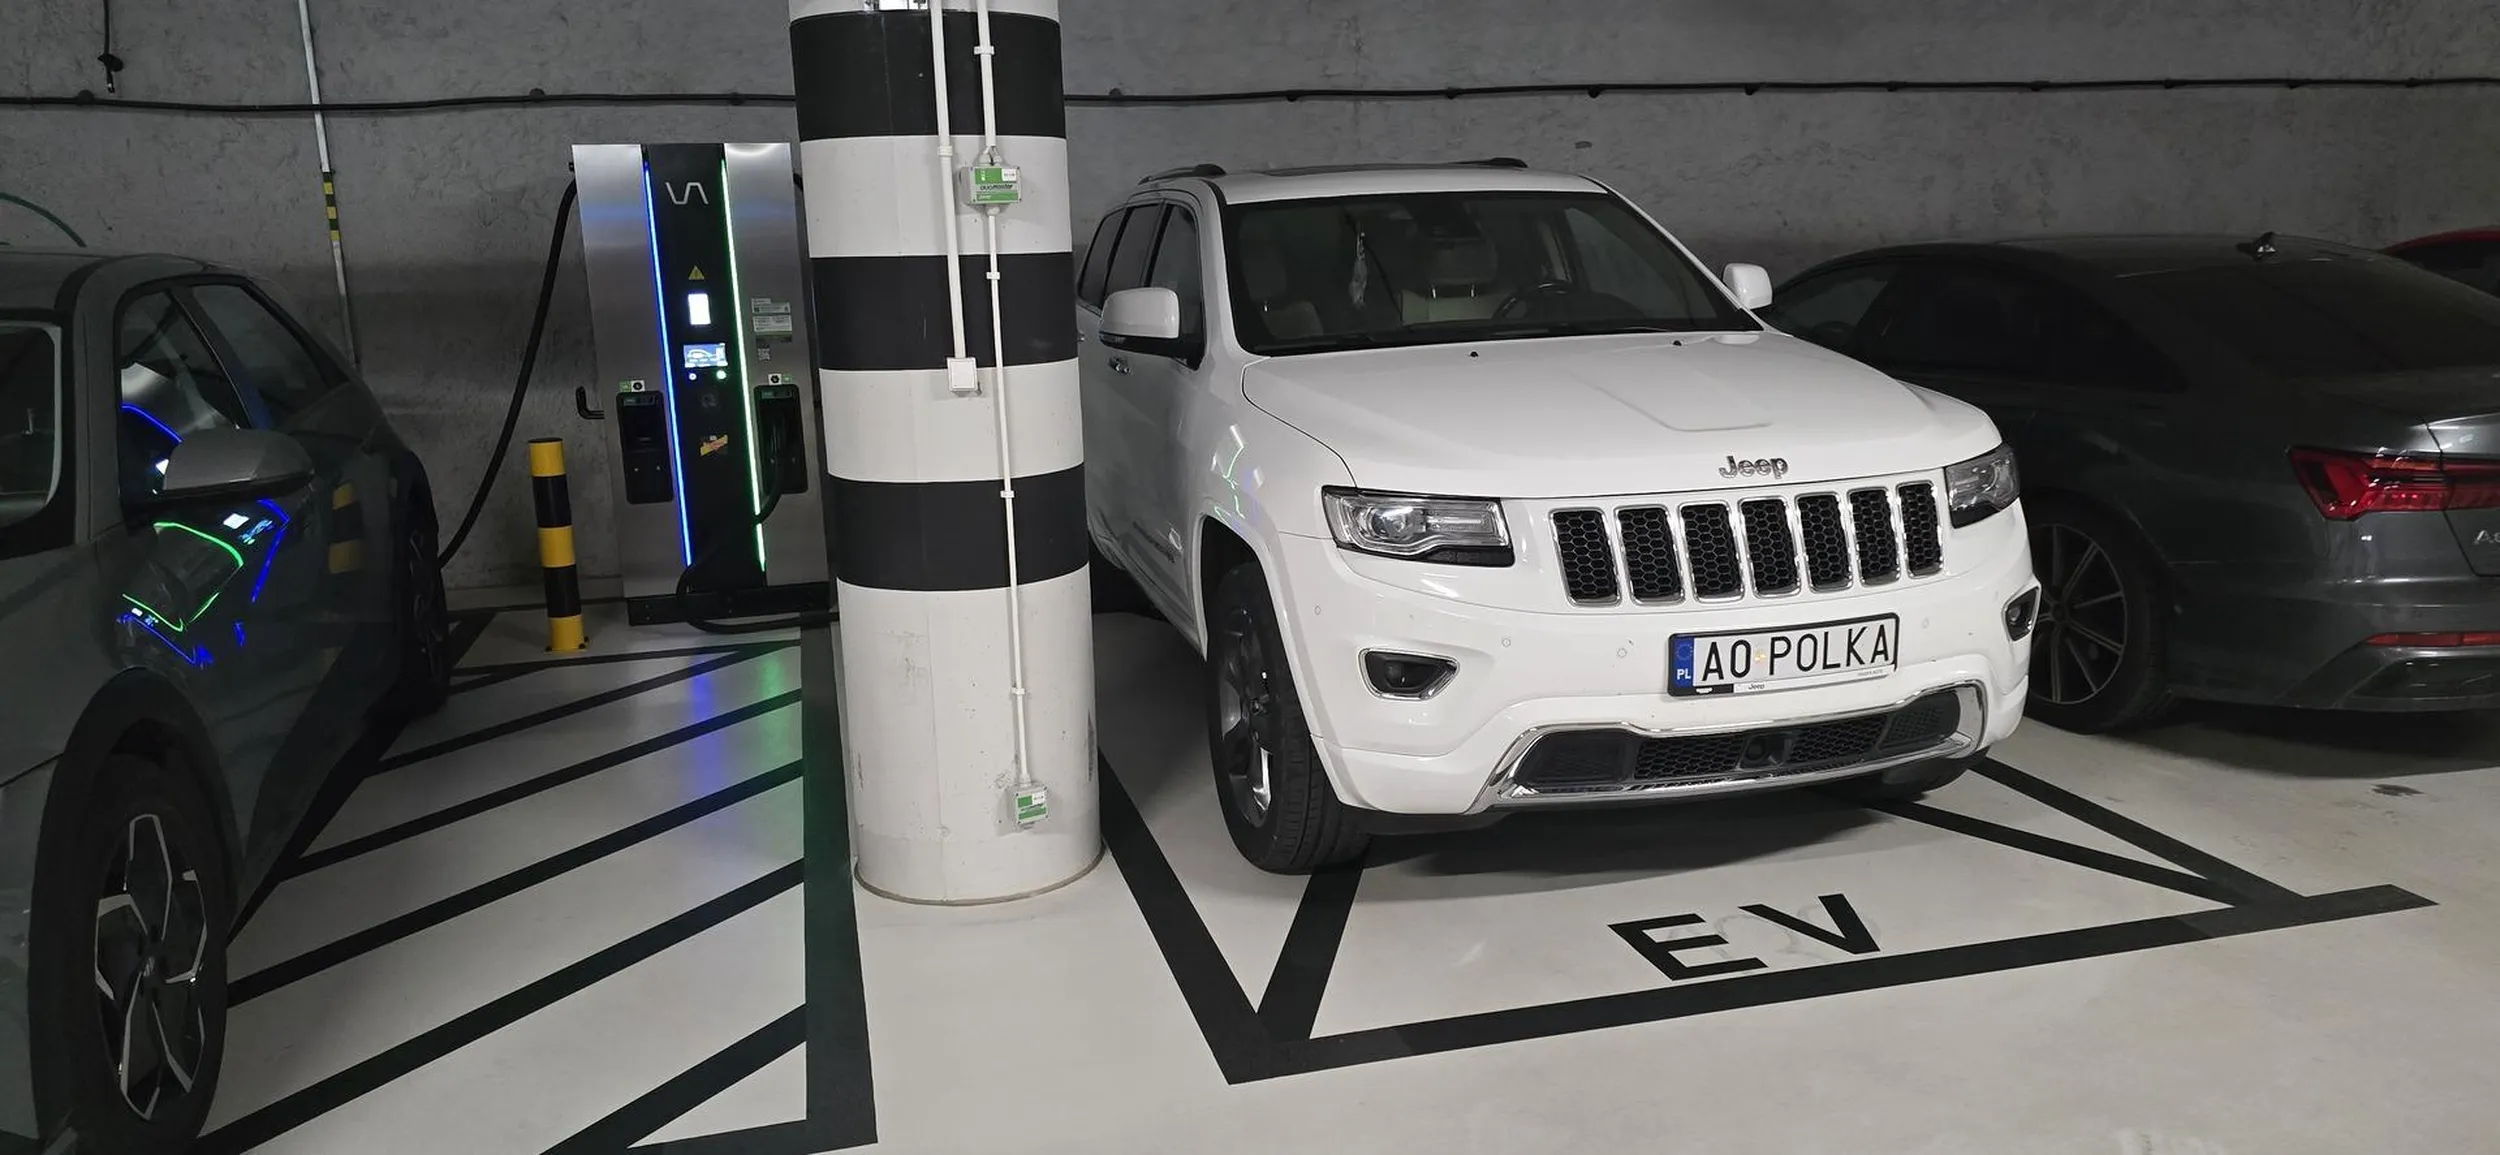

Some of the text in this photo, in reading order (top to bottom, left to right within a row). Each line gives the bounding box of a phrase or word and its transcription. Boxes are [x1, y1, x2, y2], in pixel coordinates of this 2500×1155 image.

[1718, 455, 1789, 479] Jeep
[1769, 624, 1889, 676] POLKA
[1676, 667, 1692, 680] PL
[1607, 893, 1881, 982] EV
